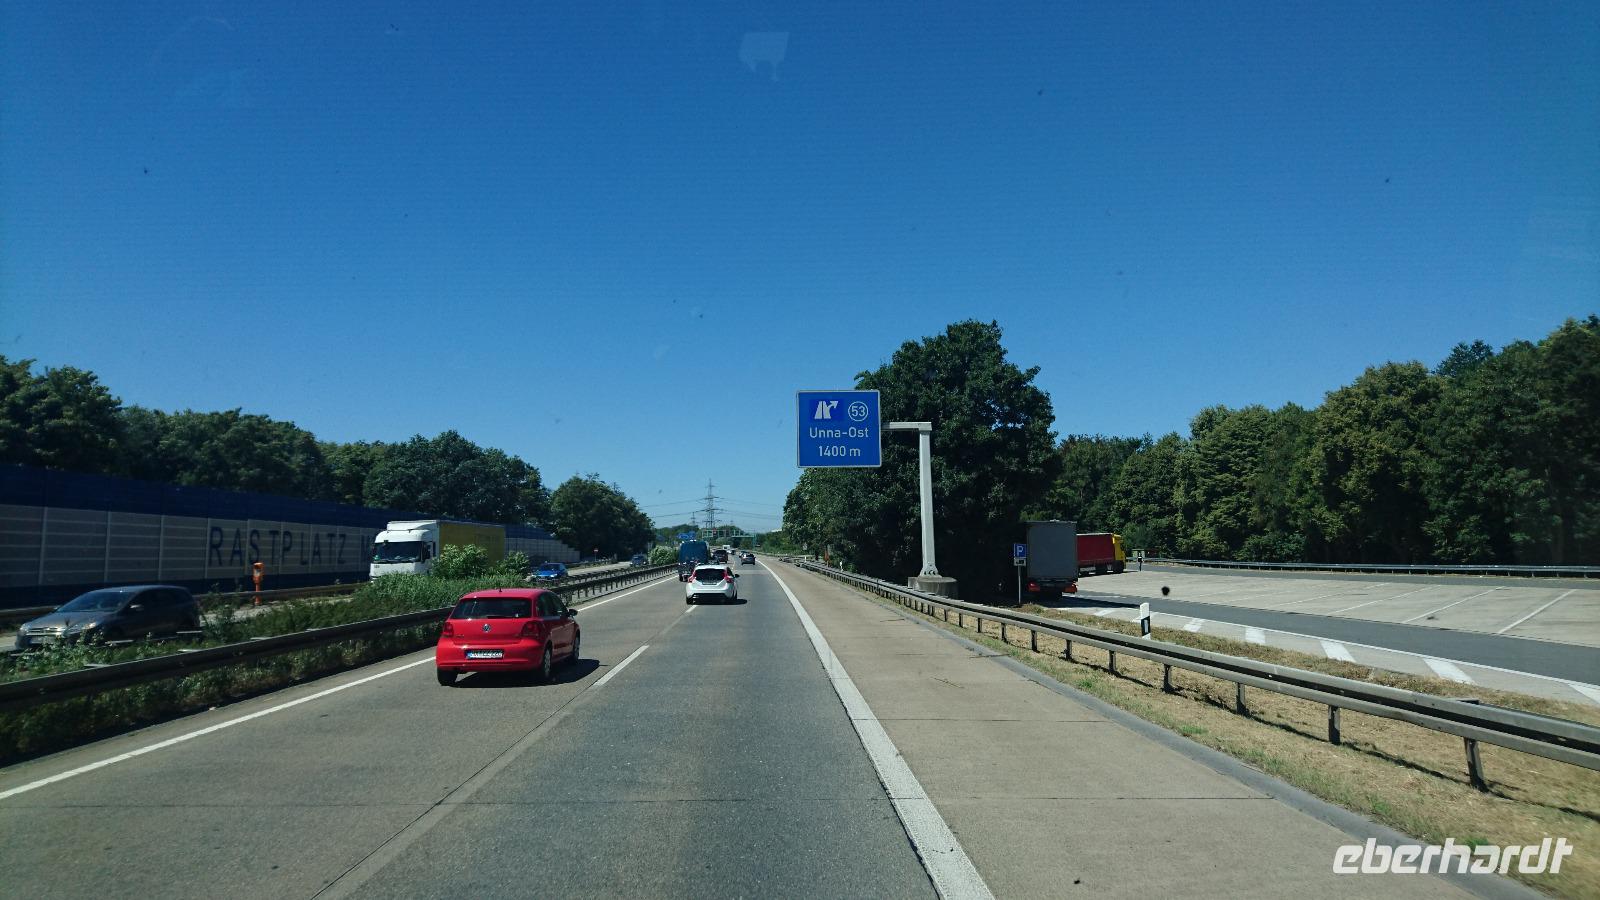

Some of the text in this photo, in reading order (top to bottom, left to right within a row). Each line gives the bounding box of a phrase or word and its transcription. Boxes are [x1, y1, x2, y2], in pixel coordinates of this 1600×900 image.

[851, 405, 866, 417] 53
[809, 426, 869, 438] Unna-Ost
[818, 445, 861, 457] 1400 m
[207, 526, 346, 566] RASTPLATZ
[1016, 545, 1024, 556] P
